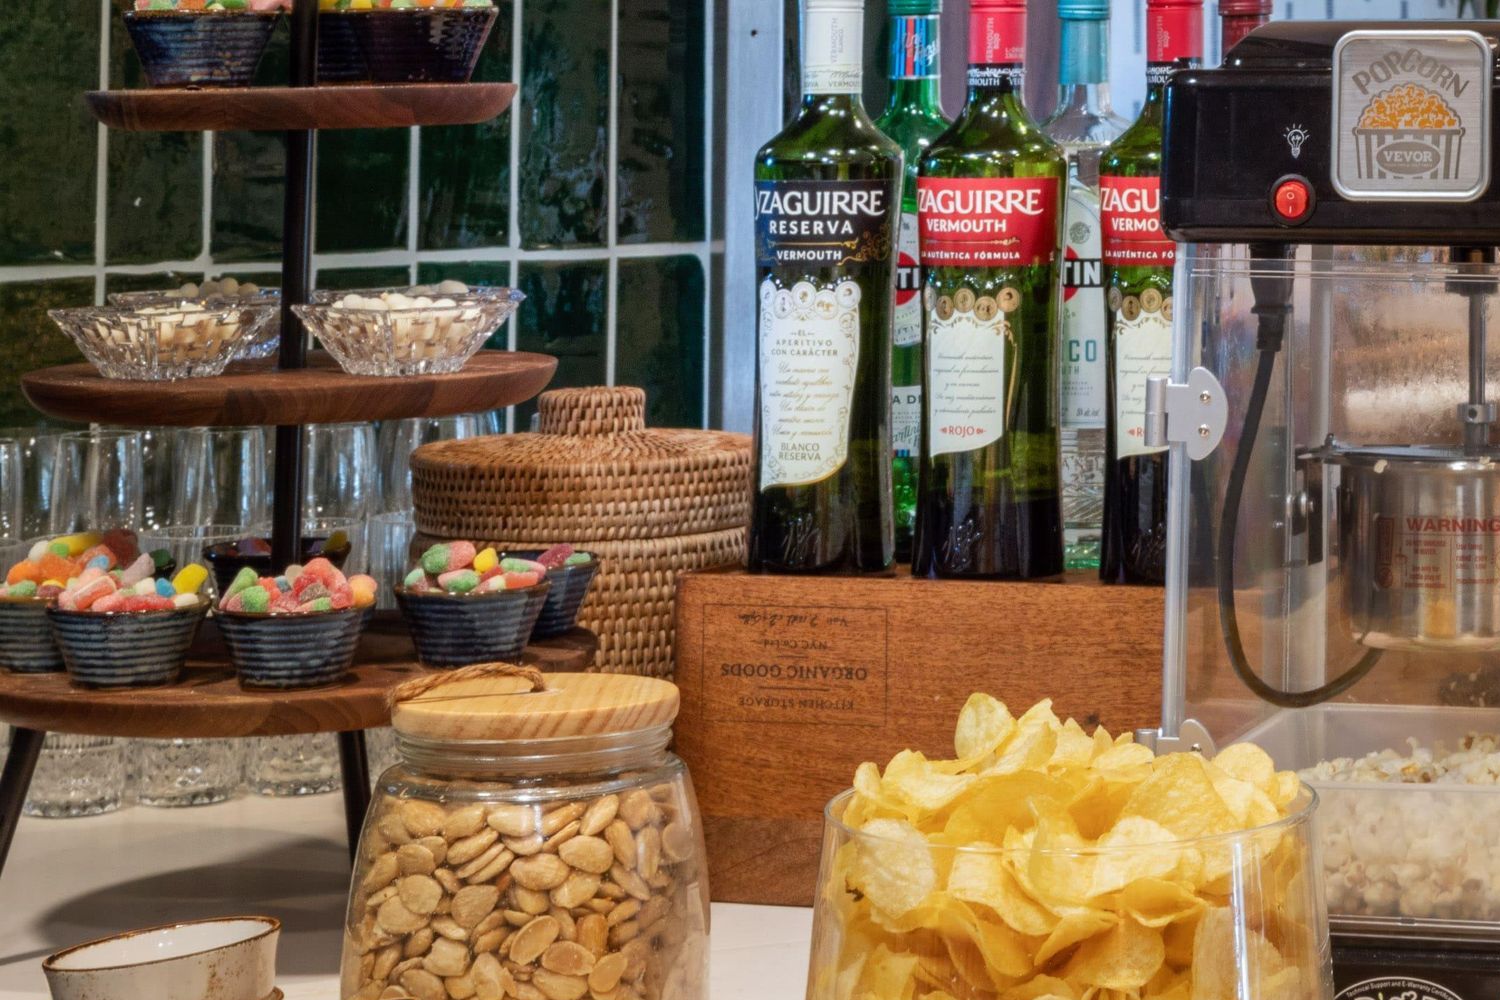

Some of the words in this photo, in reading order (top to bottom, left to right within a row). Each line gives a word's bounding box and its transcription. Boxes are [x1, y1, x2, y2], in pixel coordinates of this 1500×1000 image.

[1352, 48, 1470, 97] POPCORN
[1383, 150, 1433, 162] VEVOR
[769, 220, 854, 235] RESERVA
[926, 218, 1007, 233] VERMOUTH
[777, 250, 842, 260] VERMOUTH
[974, 249, 1020, 259] FÓRMULA
[776, 339, 833, 347] APERITIVO
[949, 425, 975, 438] ROJO
[781, 442, 820, 452] BLANCO
[778, 452, 821, 461] RESERVA
[720, 663, 782, 678] GOODS
[786, 664, 868, 681] ORGANIC
[739, 696, 795, 709] STORAGE
[799, 698, 854, 710] KITCHEN
[1346, 984, 1370, 998] Technical
[1370, 981, 1391, 991] Support
